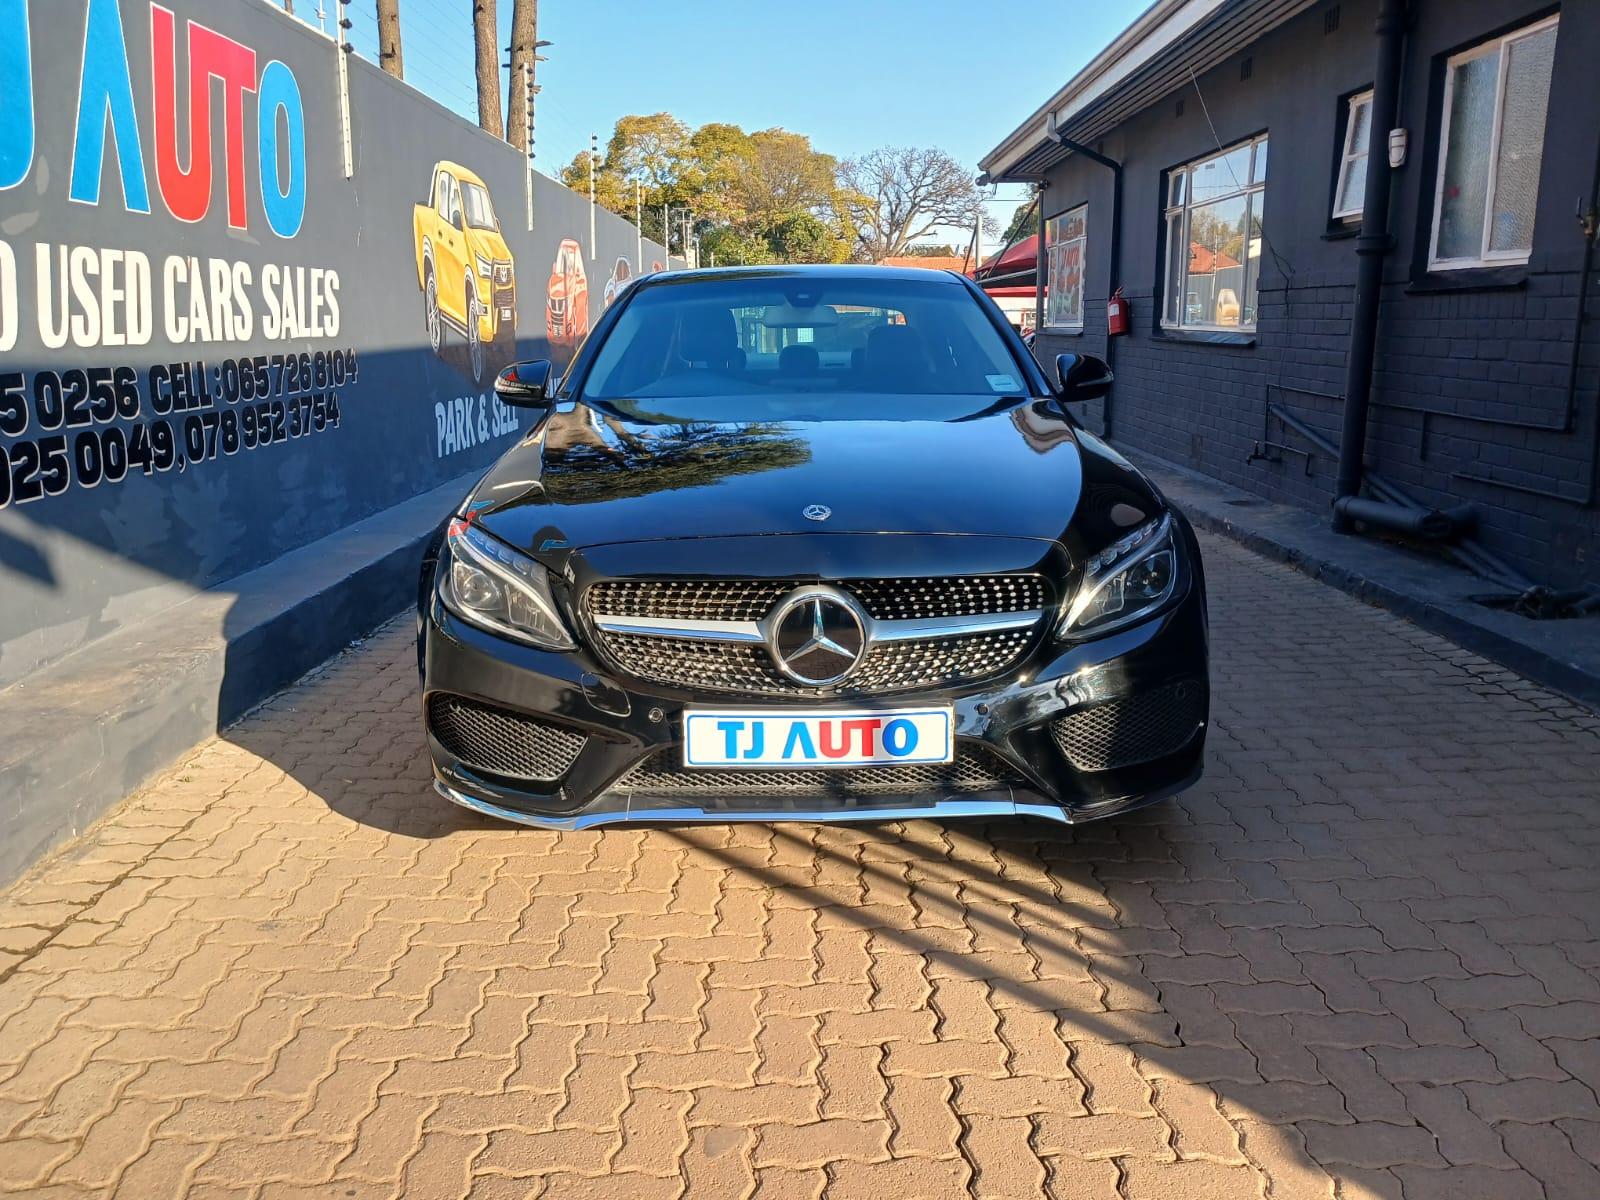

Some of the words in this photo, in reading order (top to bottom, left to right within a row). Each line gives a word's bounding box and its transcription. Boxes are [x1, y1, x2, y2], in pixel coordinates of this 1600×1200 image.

[68, 0, 306, 239] AUTO
[35, 242, 153, 349] USED
[163, 255, 253, 343] CARS
[261, 263, 341, 340] SALES
[34, 366, 141, 431] 0256
[272, 352, 312, 397] 726
[314, 347, 359, 390] 8104
[241, 400, 288, 450] 952
[288, 391, 341, 438] 3754
[434, 396, 477, 459] PARK
[477, 393, 491, 444] &
[491, 391, 519, 438] SELL
[717, 720, 765, 759] TJ
[781, 718, 919, 759] AUTO
